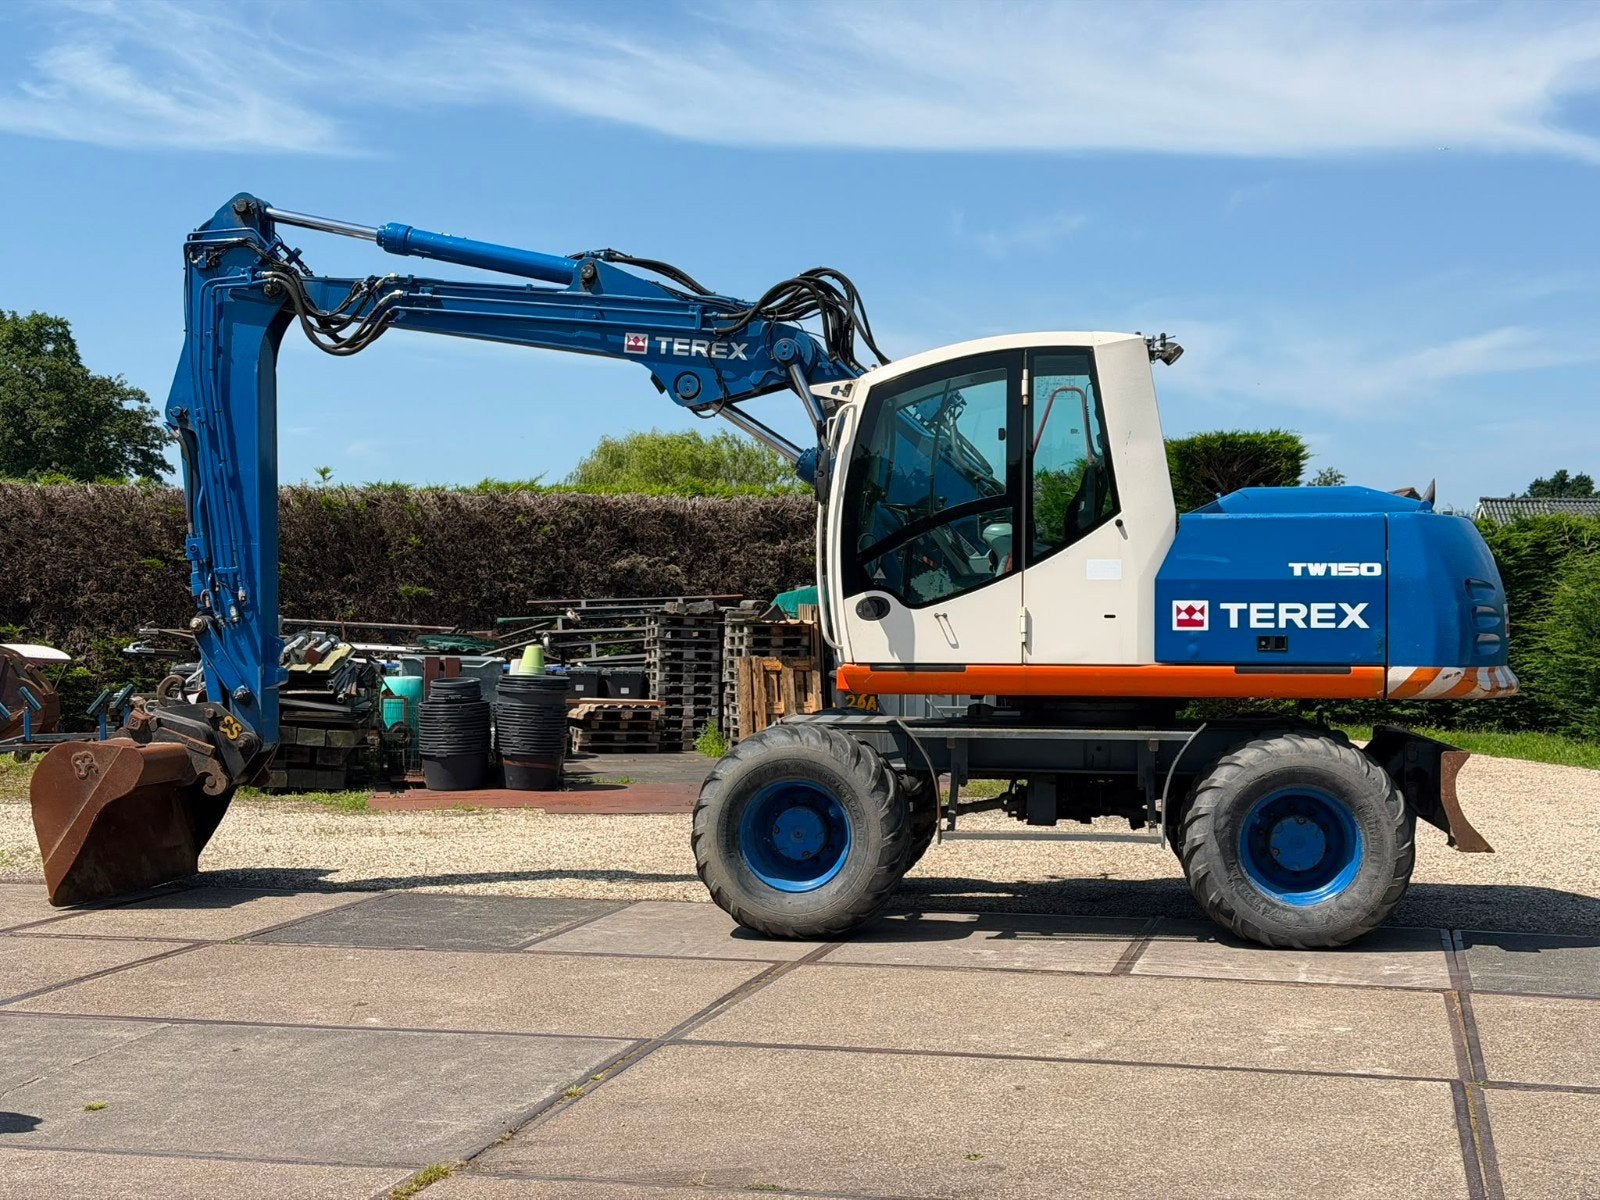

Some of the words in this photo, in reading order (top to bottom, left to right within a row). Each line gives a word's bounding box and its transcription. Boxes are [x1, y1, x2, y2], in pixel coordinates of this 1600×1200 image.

[655, 336, 749, 361] TEREX
[1288, 562, 1382, 577] TW150
[1219, 602, 1370, 629] TEREX
[845, 694, 878, 712] 26A
